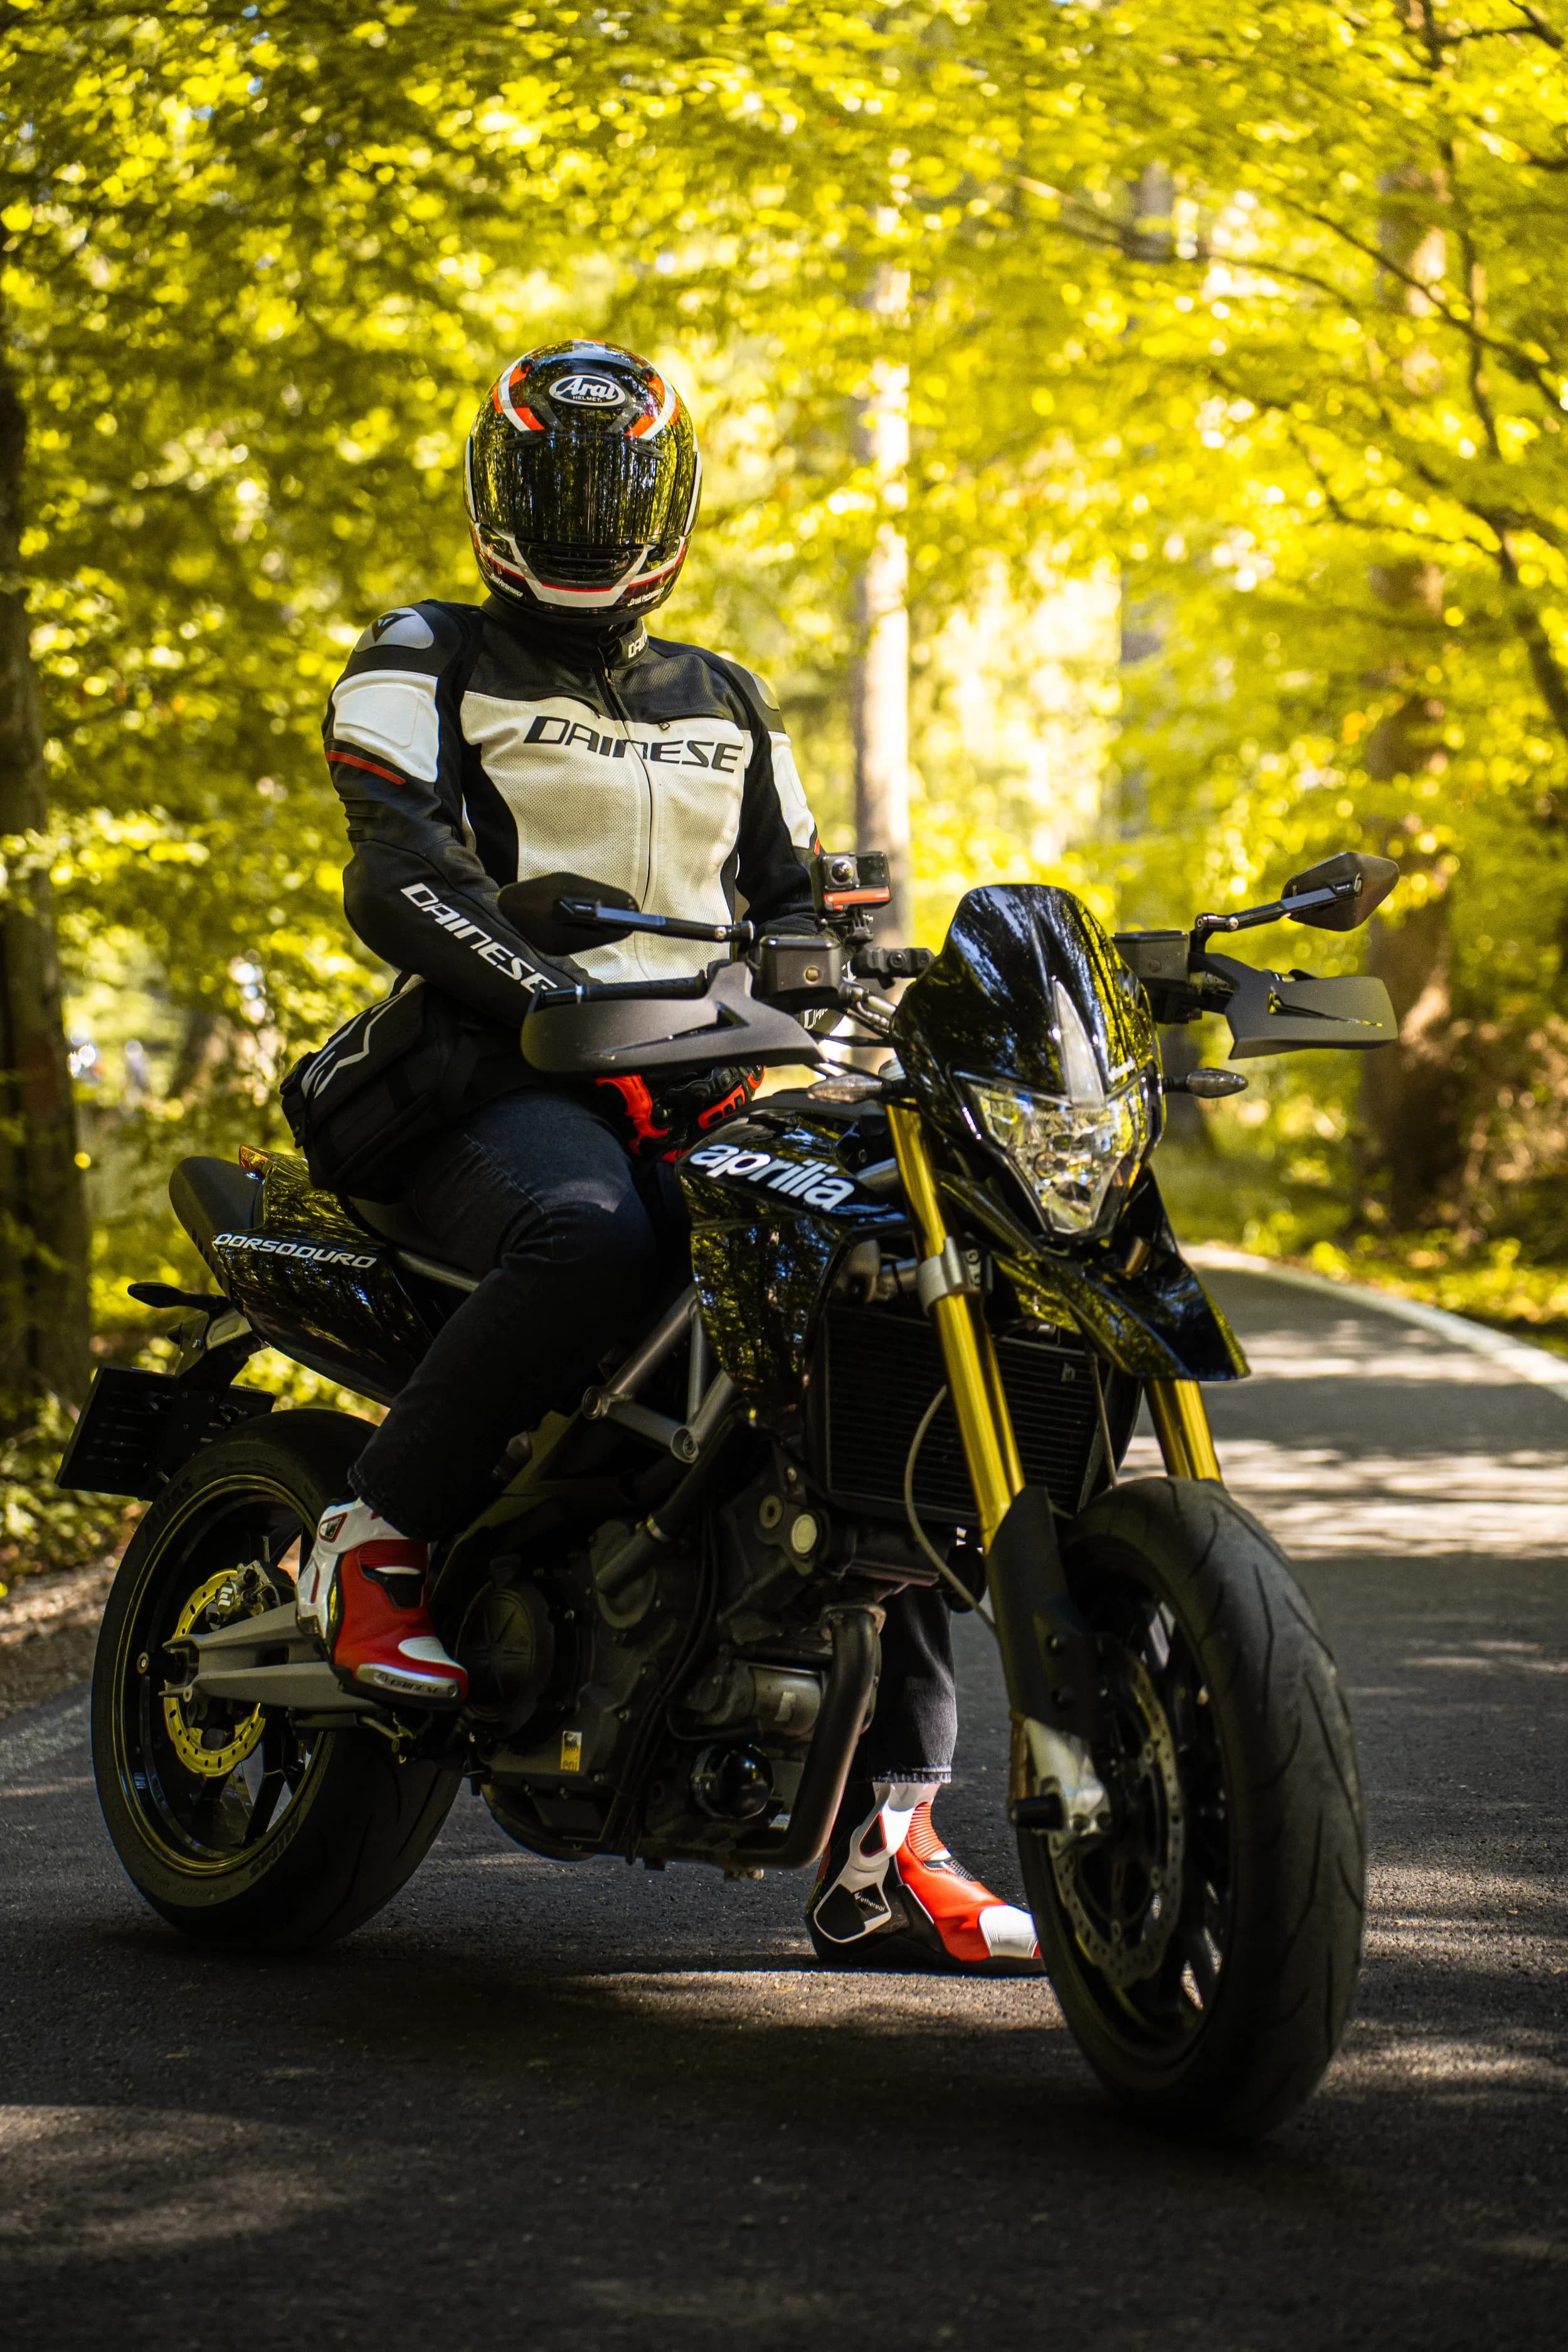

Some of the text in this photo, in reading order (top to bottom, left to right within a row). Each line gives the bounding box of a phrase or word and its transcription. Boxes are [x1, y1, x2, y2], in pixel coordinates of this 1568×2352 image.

[554, 377, 616, 400] Arai
[523, 716, 743, 773] DAINESE
[400, 882, 558, 993] DAINESE
[690, 1144, 855, 1210] aprilia
[213, 1234, 377, 1268] DORSODURO
[861, 1897, 885, 1912] ethereal
